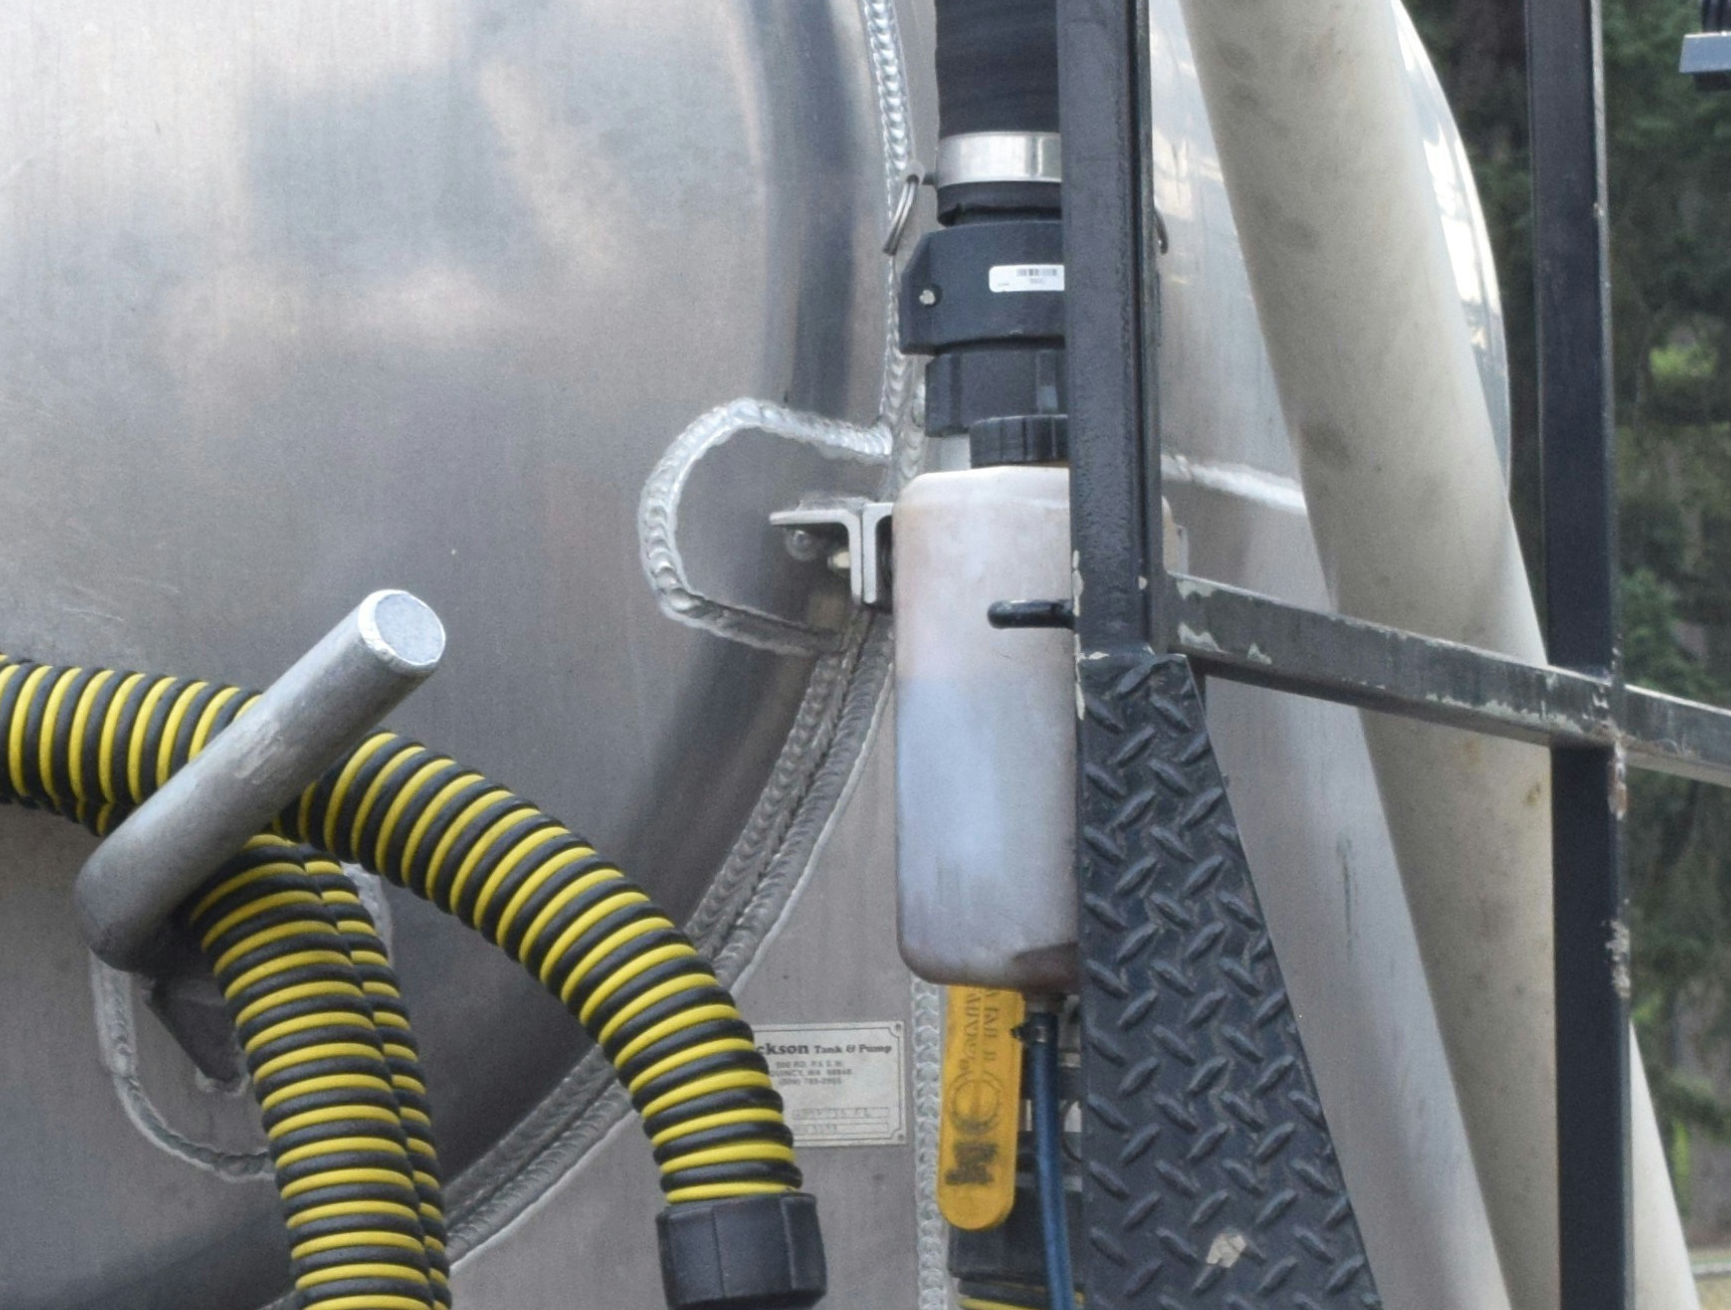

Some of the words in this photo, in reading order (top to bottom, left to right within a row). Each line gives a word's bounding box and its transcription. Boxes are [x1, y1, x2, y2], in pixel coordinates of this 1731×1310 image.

[756, 1043, 809, 1055] ckson
[814, 1045, 842, 1054] Tank
[859, 1043, 892, 1054] Pump
